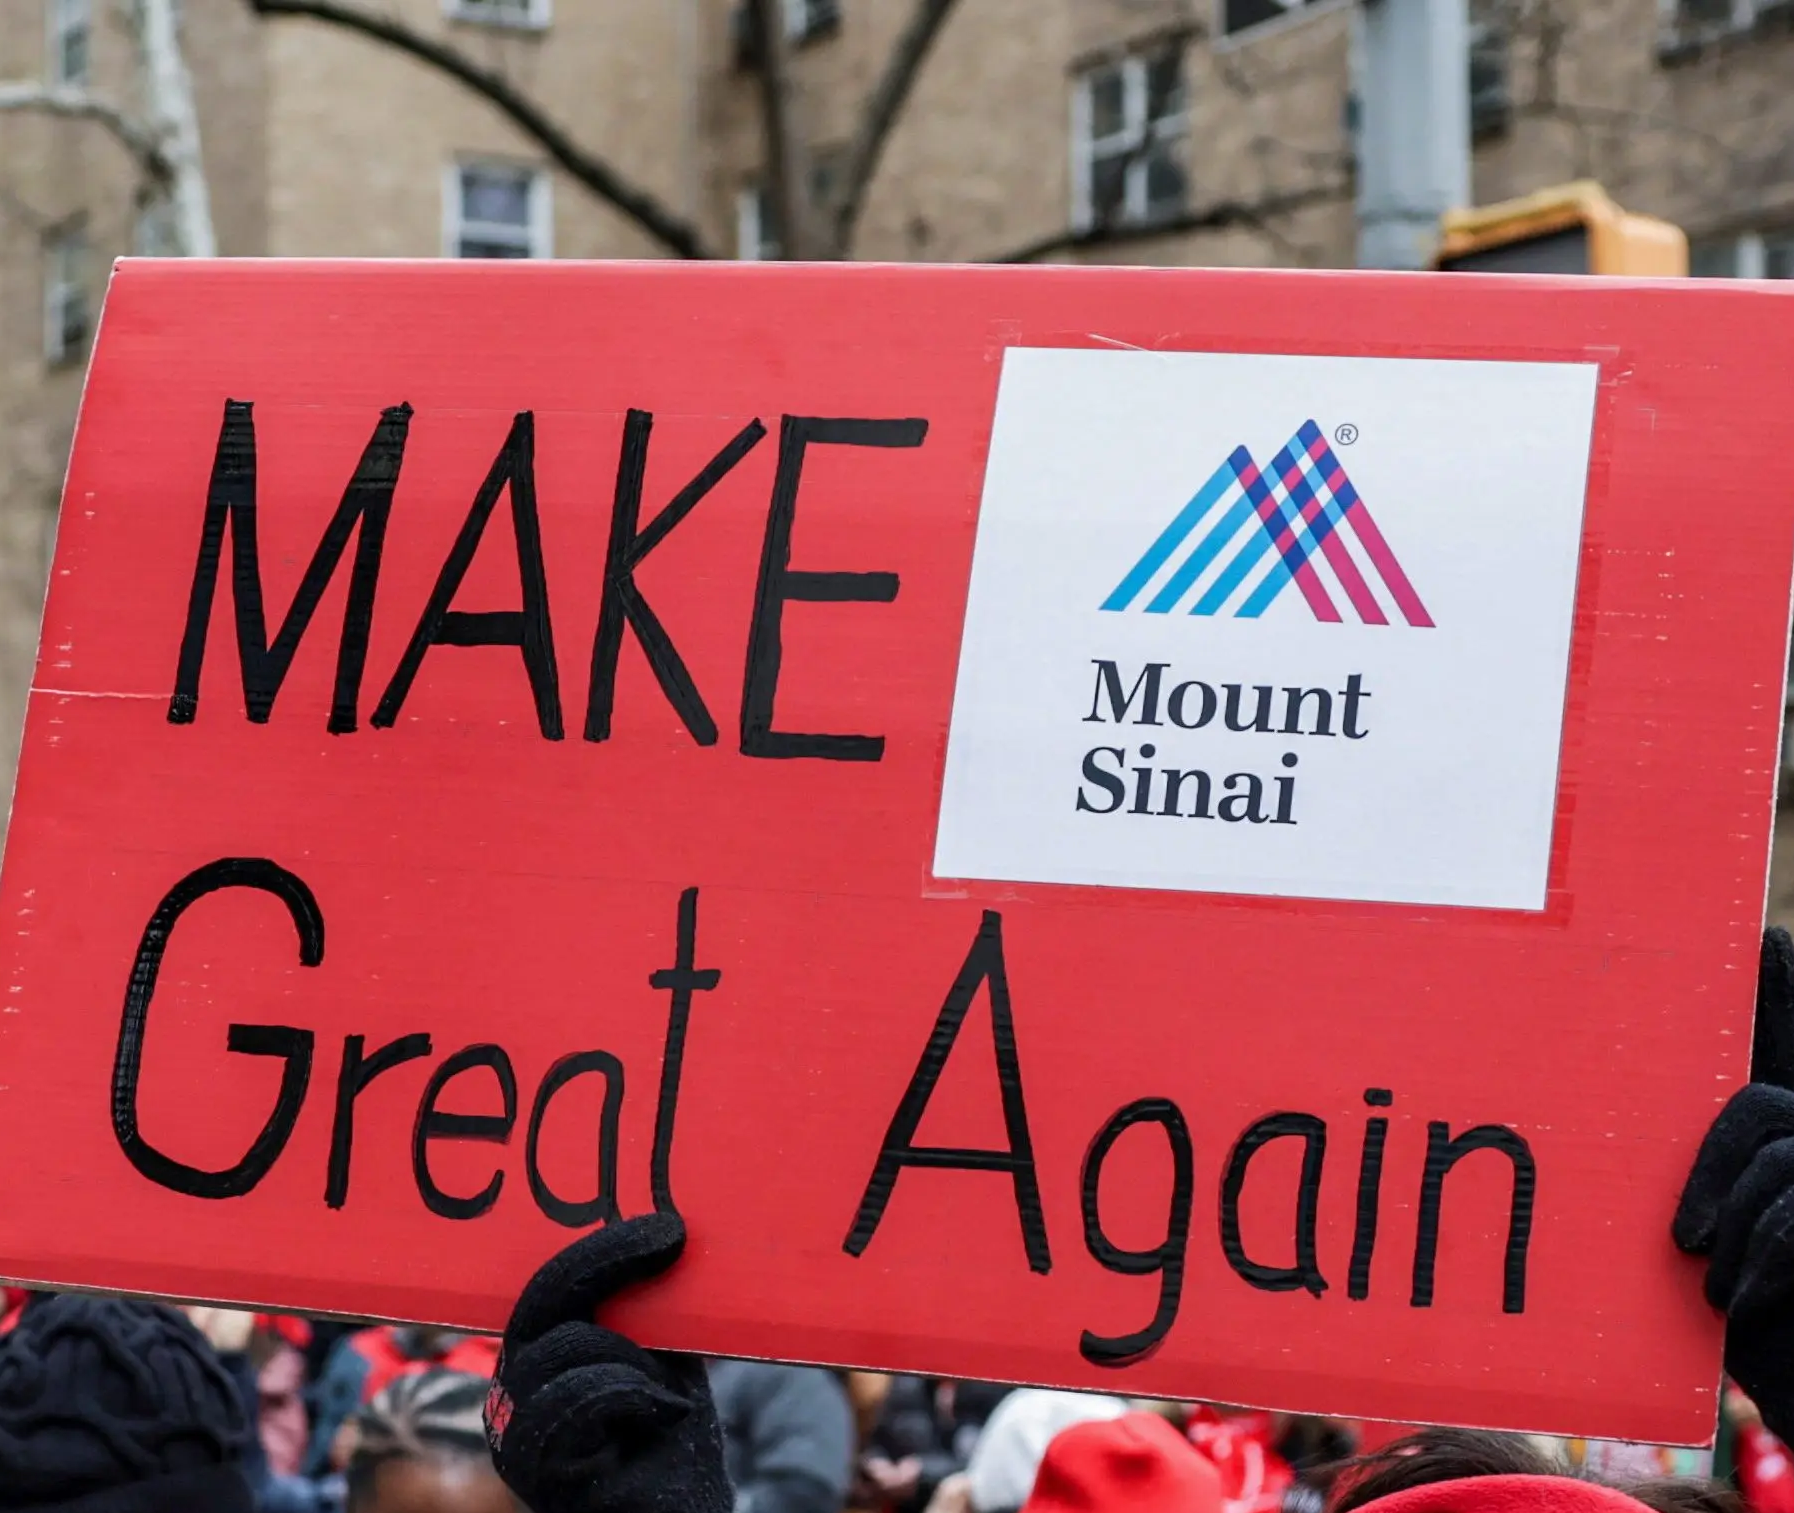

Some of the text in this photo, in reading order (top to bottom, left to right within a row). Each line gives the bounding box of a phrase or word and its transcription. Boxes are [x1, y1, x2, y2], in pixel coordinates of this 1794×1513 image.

[167, 399, 928, 761] MAKE
[1075, 743, 1298, 824] Sinai
[1083, 659, 1372, 739] Mount
[111, 857, 1535, 1368] Great Again
